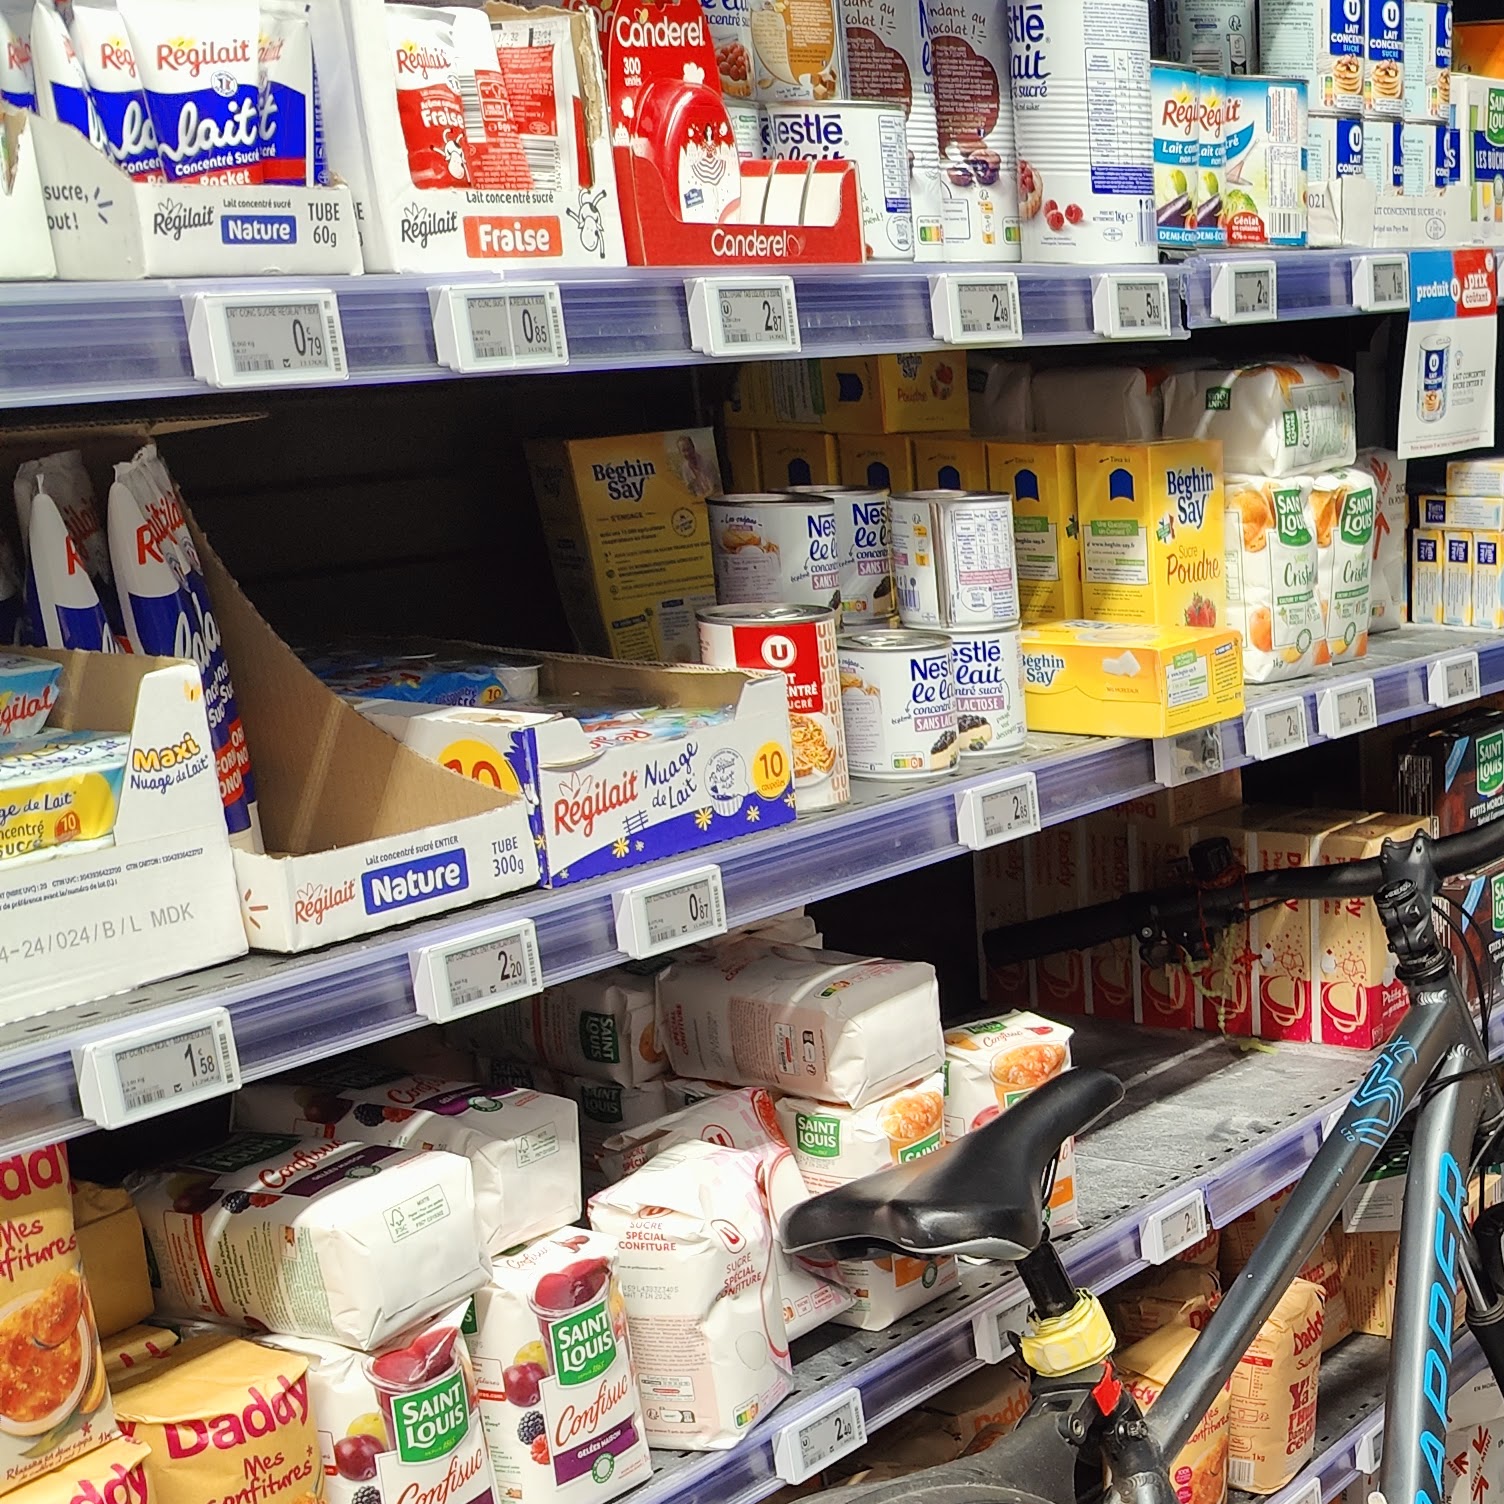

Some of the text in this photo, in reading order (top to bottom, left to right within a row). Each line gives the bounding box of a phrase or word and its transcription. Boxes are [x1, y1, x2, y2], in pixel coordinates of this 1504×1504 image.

[615, 8, 705, 49] Canderel
[1384, 30, 1398, 40] LAIT
[156, 41, 250, 76] Régilait
[623, 57, 641, 75] 300
[421, 107, 465, 129] Fraise
[175, 153, 234, 177] Concentré
[1475, 150, 1486, 170] LES
[44, 183, 90, 203] sucre,
[467, 192, 484, 204] Lait
[486, 191, 530, 204] concentré
[153, 204, 214, 240] Régilait
[307, 202, 340, 222] TUBE
[227, 219, 291, 241] Nature
[312, 227, 337, 247] 60g
[401, 210, 458, 249] Régilait
[479, 223, 550, 252] Fraise
[711, 228, 789, 257] Canderel
[1417, 281, 1450, 302] produit
[1468, 270, 1488, 290] prix
[592, 459, 656, 482] Béghin
[608, 477, 646, 501] Say
[1166, 467, 1214, 499] Béghin
[1178, 493, 1205, 529] Say
[1350, 495, 1372, 515] SAINT
[1344, 515, 1373, 534] LOUIS
[1166, 548, 1221, 587] Poudre
[957, 697, 1000, 712] LACTOSE
[133, 732, 201, 773] Maxi
[1479, 738, 1503, 759] SAINT
[130, 773, 174, 795] Nuage
[187, 755, 209, 779] Lait
[643, 741, 698, 788] Nuage
[759, 751, 783, 777] 10
[1479, 759, 1504, 781] LOUIS
[43, 791, 73, 811] Lait
[553, 770, 639, 837] Régilait
[652, 779, 697, 811] de Lait
[491, 836, 519, 855] TUBE
[492, 856, 525, 878] 300g
[371, 861, 462, 907] Nature
[294, 879, 356, 925] Régilait
[151, 902, 195, 928] MDK
[798, 1114, 837, 1133] SAINT
[800, 1128, 837, 1148] LOUIS
[625, 1230, 667, 1244] SPÉCIAL
[629, 1221, 663, 1231] SUCRE
[618, 1241, 677, 1252] CONFITURE
[724, 1262, 759, 1288] SPÉCIAL
[726, 1251, 753, 1275] SUCRE
[558, 1310, 610, 1351] SAINT
[561, 1330, 613, 1373] LOUIS
[402, 1381, 461, 1423] SAINT
[554, 1375, 628, 1448] Confisuc
[163, 1374, 309, 1460] Daddy
[405, 1400, 465, 1451] LOUIS
[243, 1452, 285, 1479] Mes
